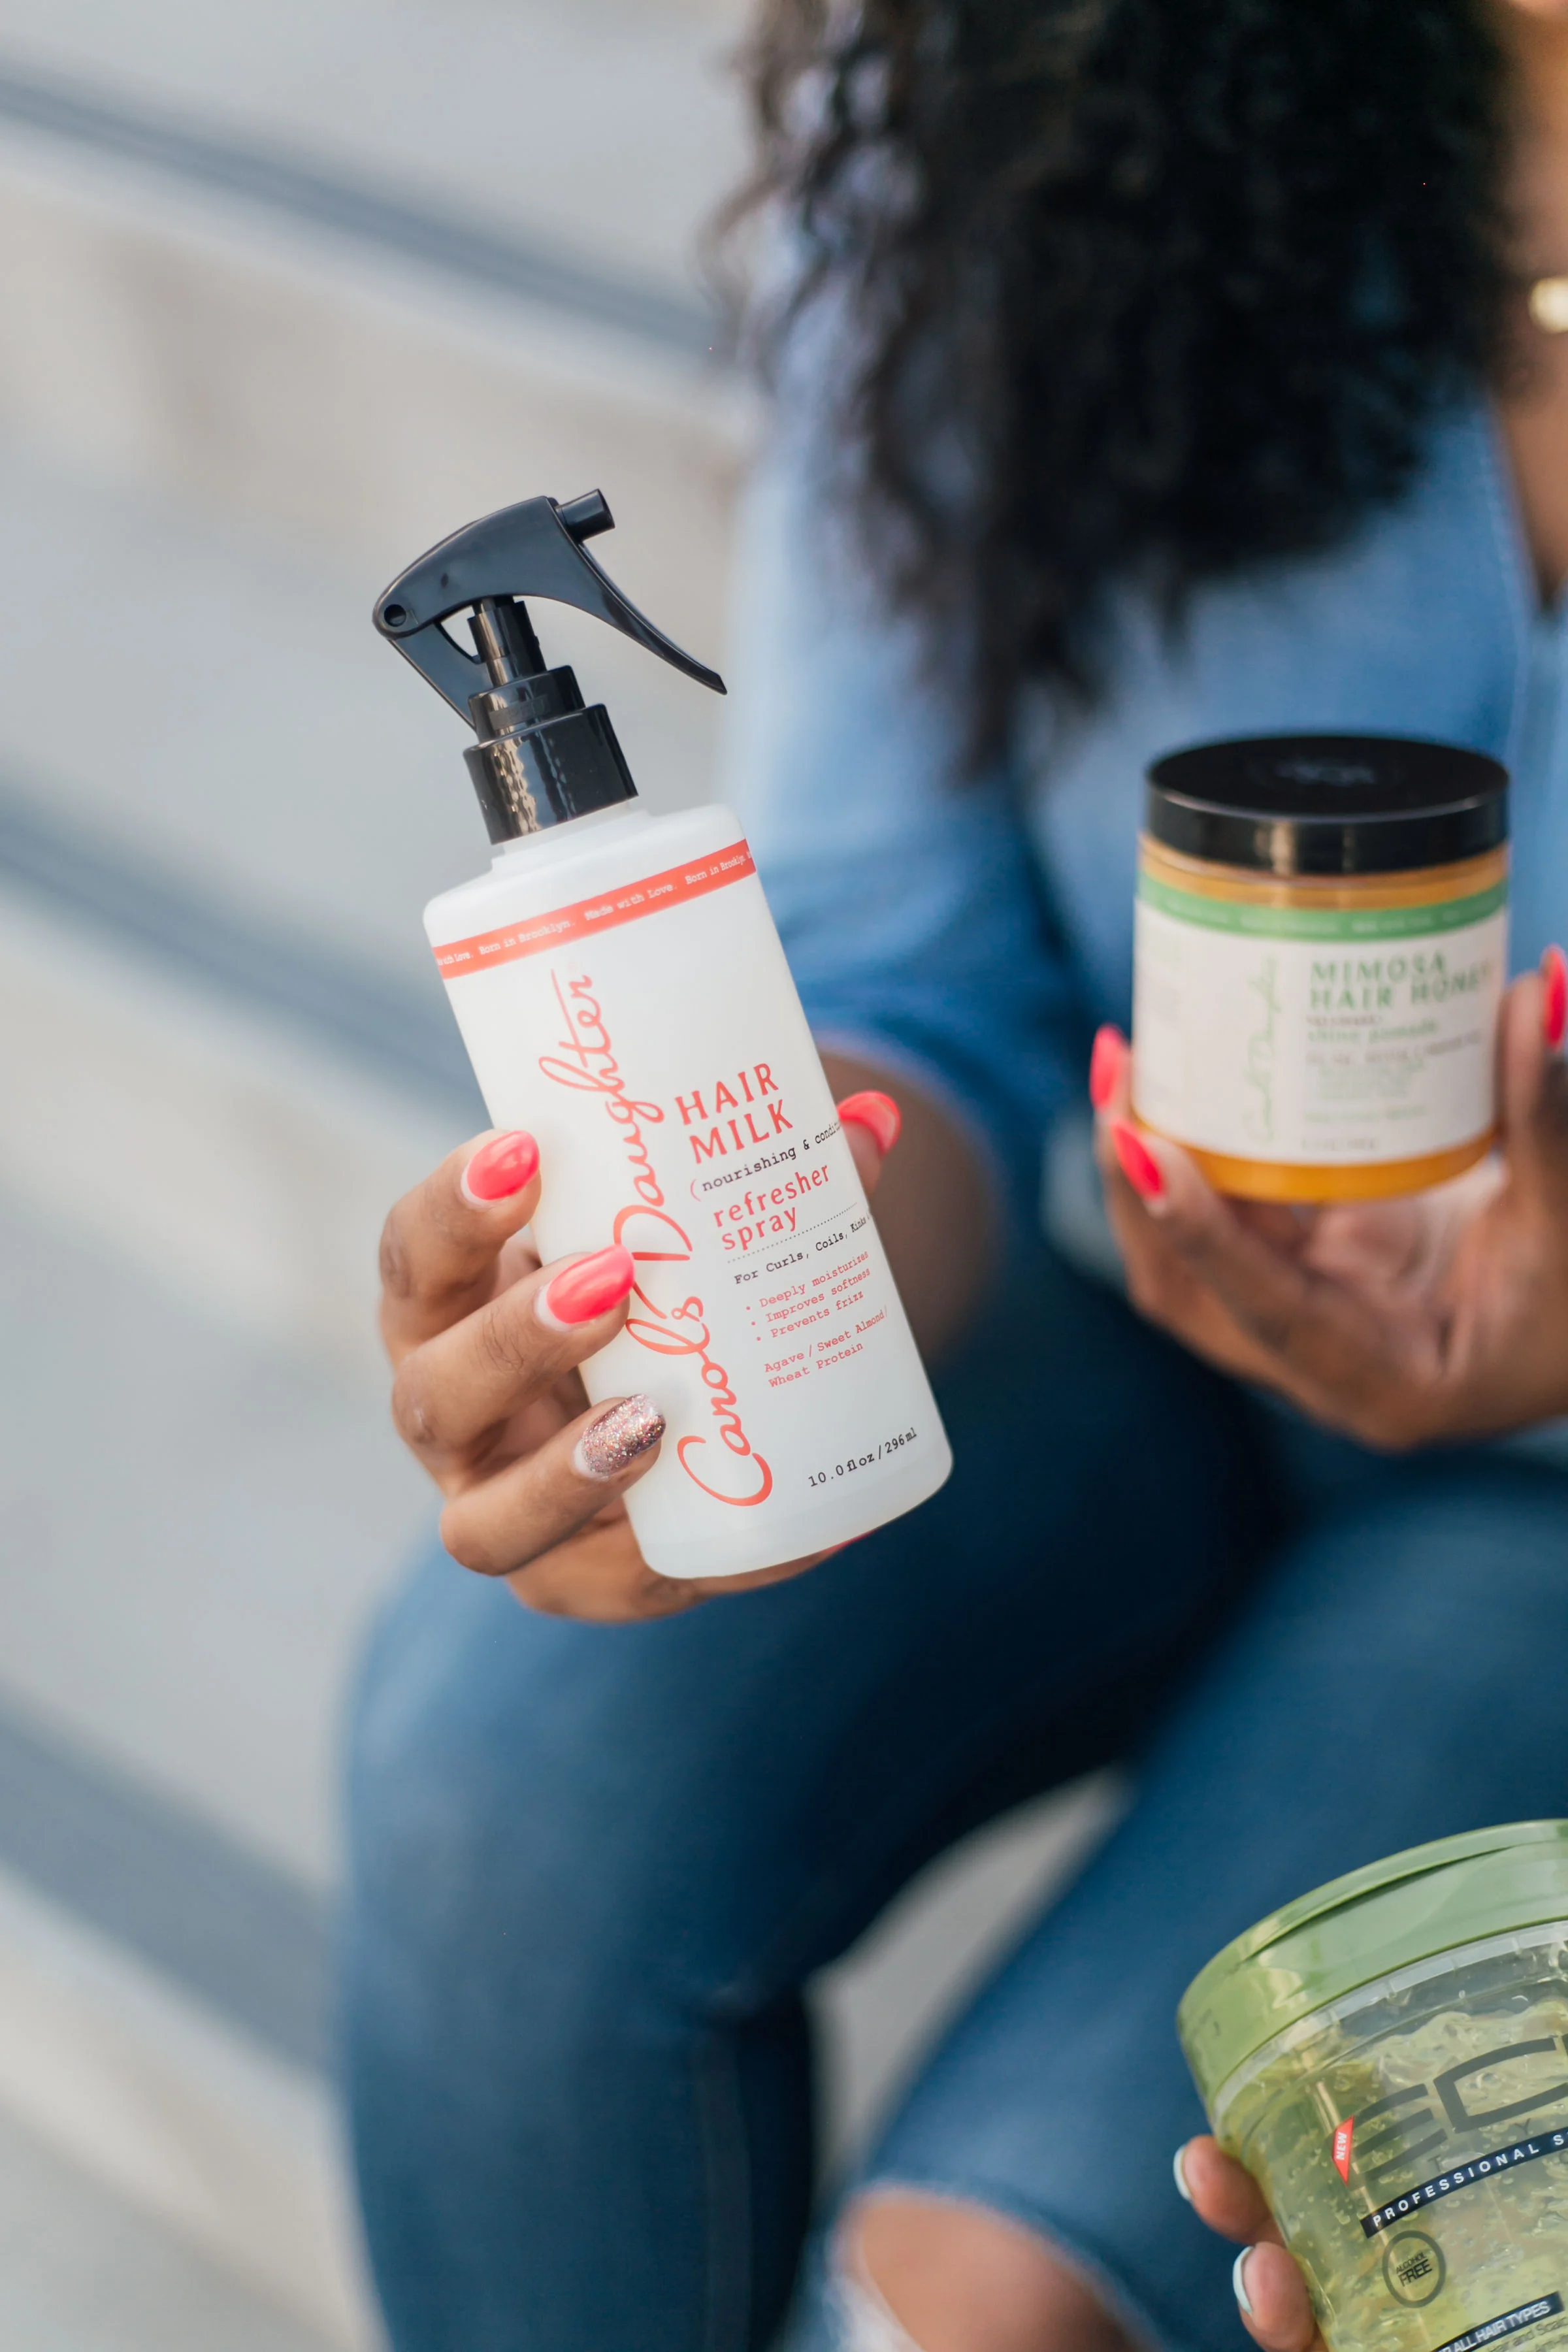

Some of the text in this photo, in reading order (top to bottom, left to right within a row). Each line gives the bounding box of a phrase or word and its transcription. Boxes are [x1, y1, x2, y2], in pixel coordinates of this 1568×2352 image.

[478, 942, 501, 955] Born
[504, 938, 516, 947] in
[617, 894, 645, 909] with
[685, 870, 707, 885] Born
[710, 865, 719, 875] in
[675, 1062, 779, 1125] HAIR
[538, 969, 693, 1319] Daughter
[689, 1099, 793, 1164] MILK
[803, 1139, 810, 1150] &
[713, 1165, 829, 1228] refresher
[721, 1207, 796, 1250] spray
[734, 1270, 759, 1284] For
[766, 1252, 809, 1273] Curls,
[815, 1231, 848, 1251] Coils,
[759, 1251, 869, 1307] Deeply moisturizes
[766, 1267, 871, 1322] Improves softness
[770, 1290, 864, 1338] Prevents frizz
[764, 1352, 805, 1373] Agave
[817, 1330, 852, 1352] Sweet
[768, 1343, 864, 1388] Wheat Protein
[1335, 2132, 1347, 2160] NEW
[1373, 2131, 1568, 2227] PROFESSIONAL S
[1398, 2259, 1433, 2287] FREE
[1475, 2319, 1507, 2343] HAIR
[1505, 2300, 1551, 2327] TYPES
